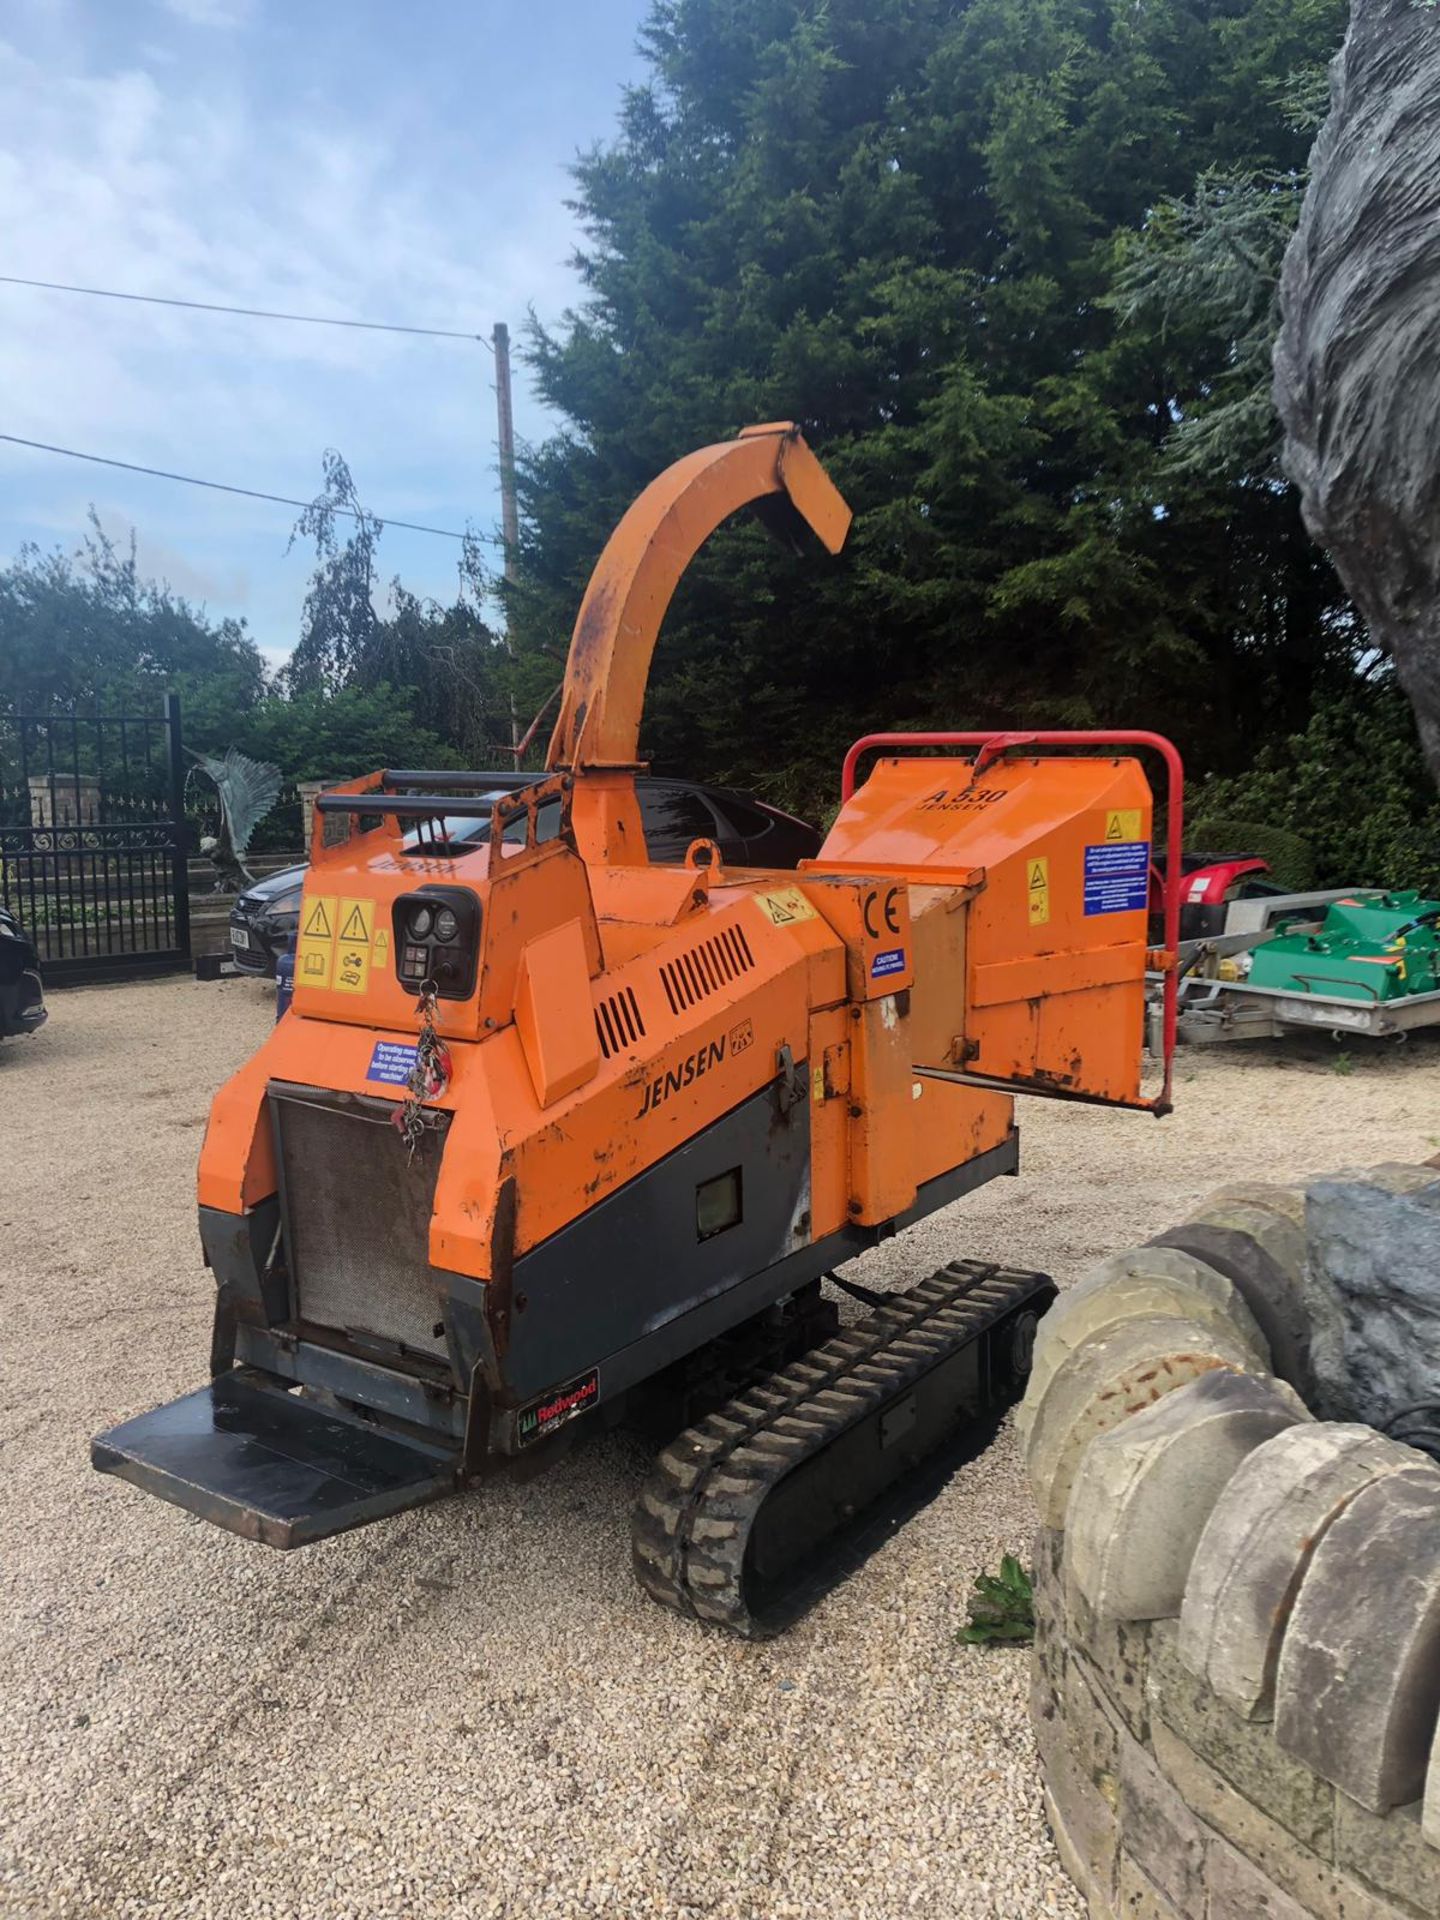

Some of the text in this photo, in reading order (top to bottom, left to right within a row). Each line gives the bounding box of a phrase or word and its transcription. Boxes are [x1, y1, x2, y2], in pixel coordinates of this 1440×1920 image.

[923, 788, 1009, 804] A 530
[917, 803, 990, 812] JENSEN
[368, 859, 463, 873] JENSEN
[392, 1055, 416, 1066] observe
[634, 1034, 727, 1121] JENSEN
[537, 1377, 597, 1424] Redwood
